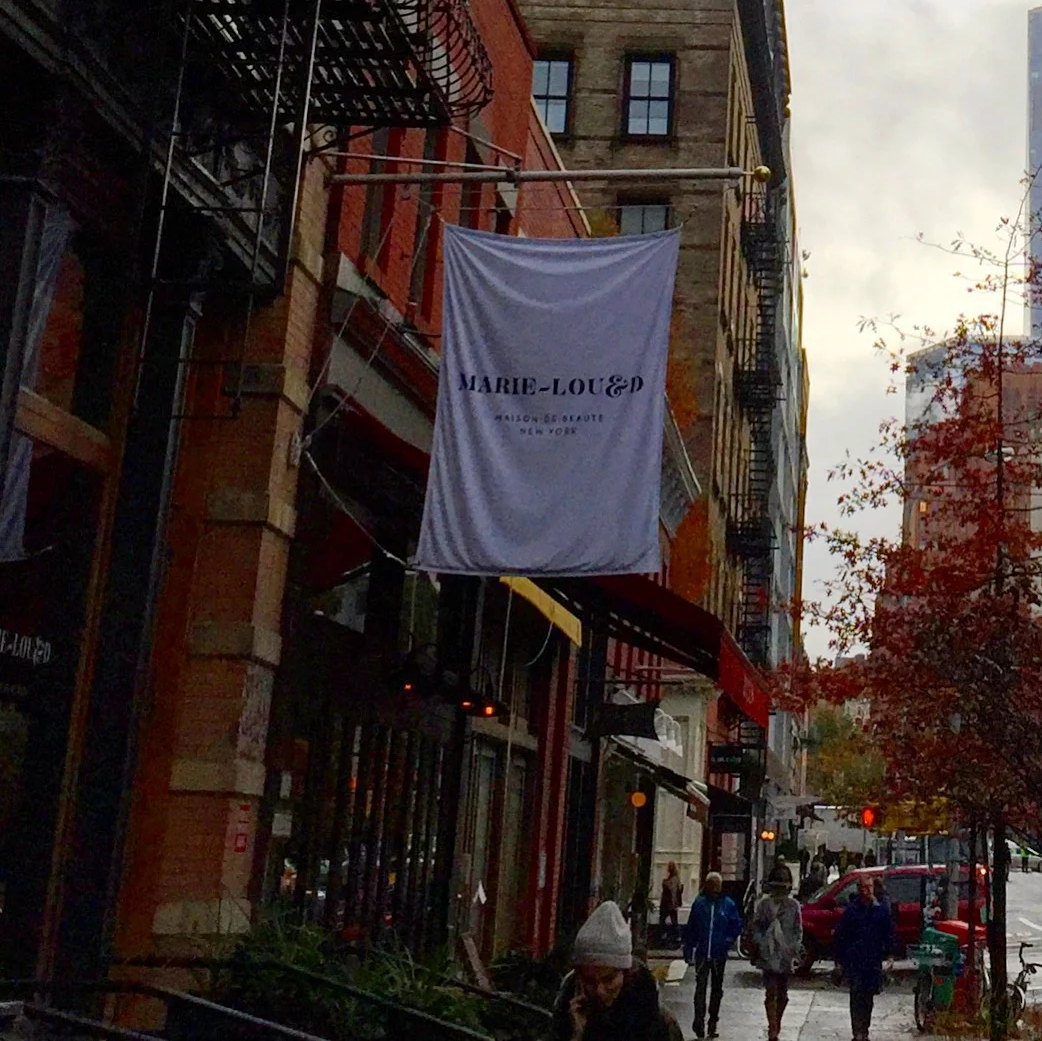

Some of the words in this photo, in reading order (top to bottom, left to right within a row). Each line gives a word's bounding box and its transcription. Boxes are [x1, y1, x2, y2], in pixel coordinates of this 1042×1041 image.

[493, 414, 539, 423] MAISON
[519, 427, 544, 436] NEW
[548, 426, 578, 436] YORK
